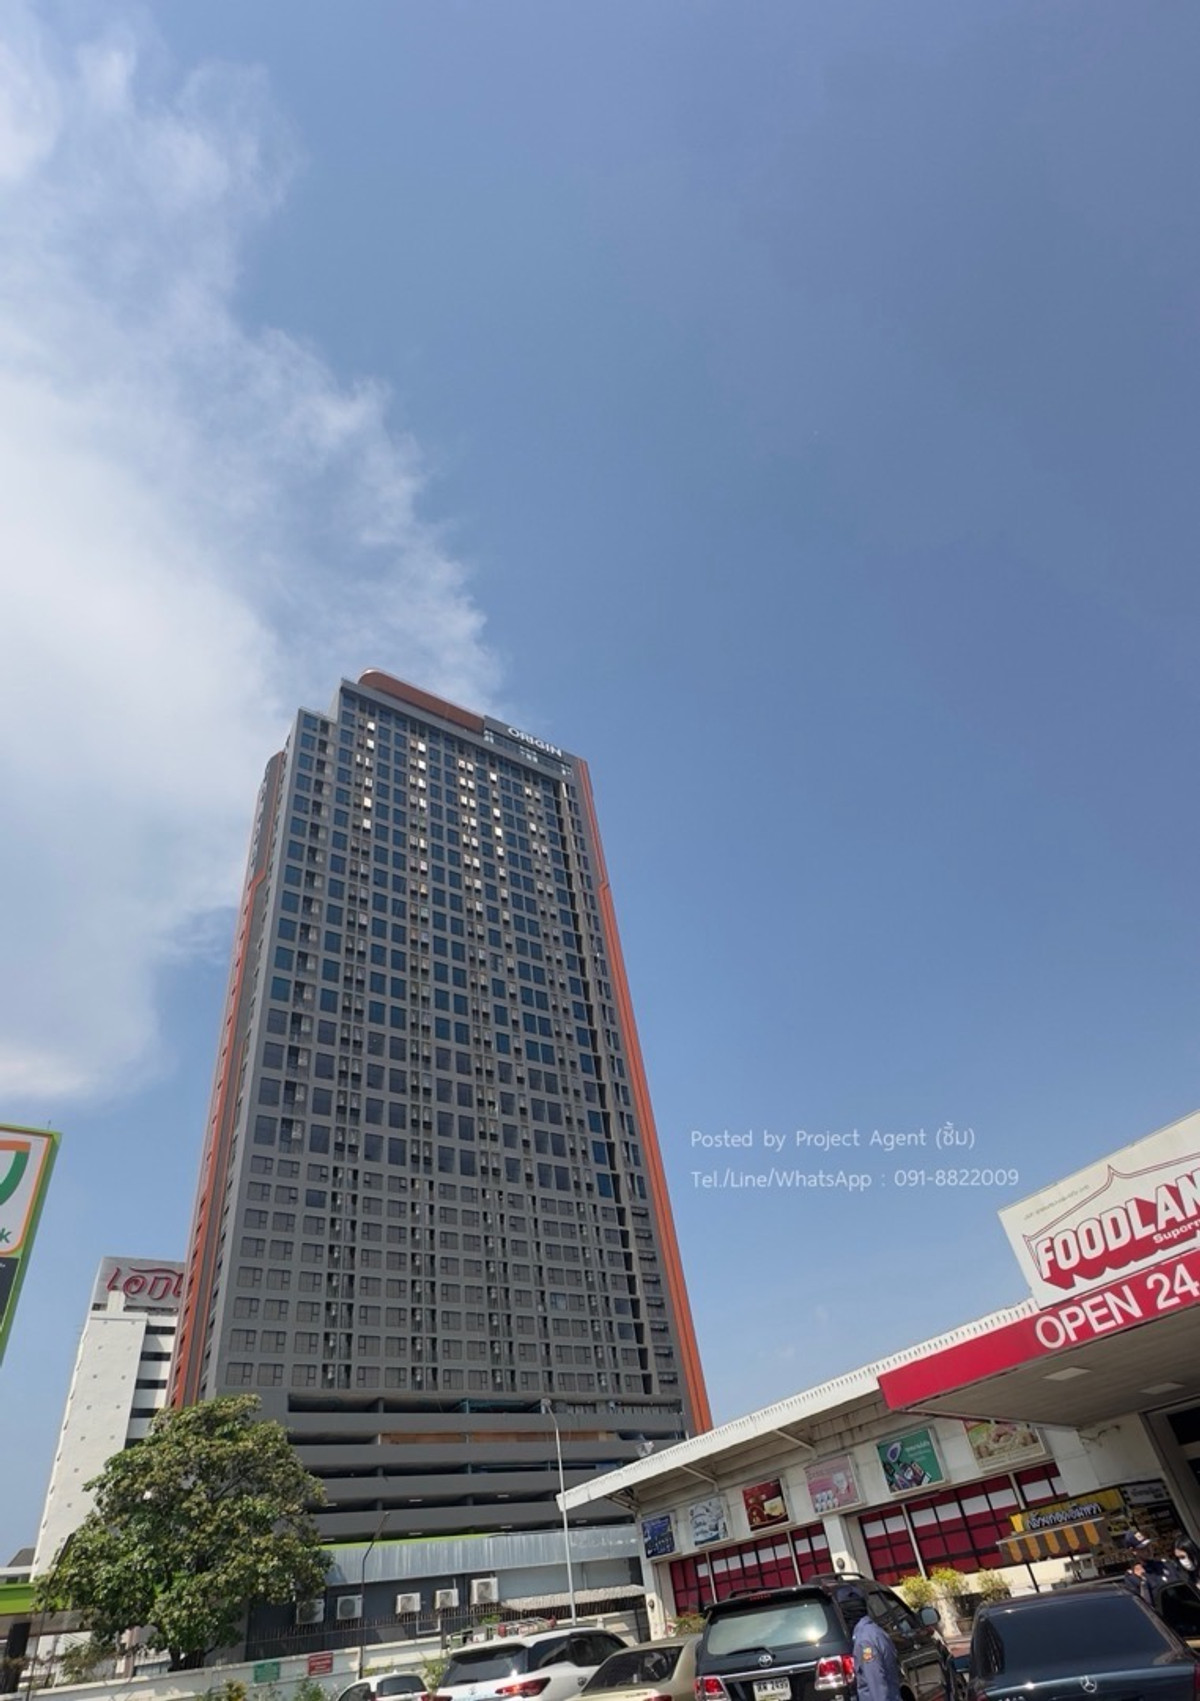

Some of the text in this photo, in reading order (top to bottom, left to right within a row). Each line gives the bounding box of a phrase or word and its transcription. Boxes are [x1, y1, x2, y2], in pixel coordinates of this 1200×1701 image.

[508, 727, 562, 758] ORIGIN
[1035, 1263, 1200, 1349] OPEN 24
